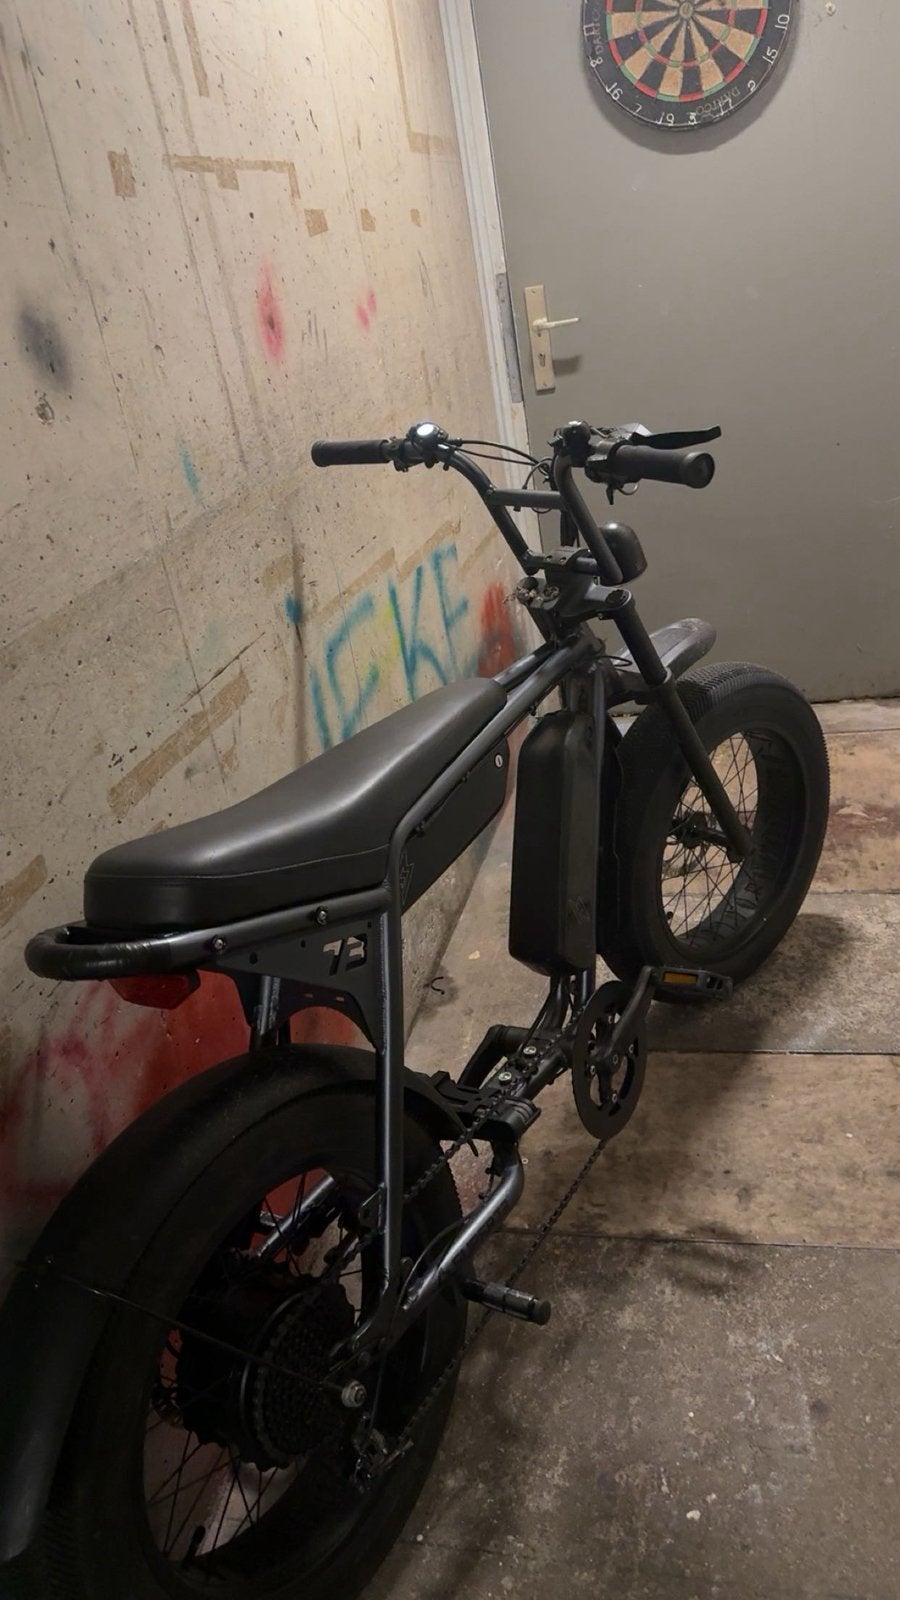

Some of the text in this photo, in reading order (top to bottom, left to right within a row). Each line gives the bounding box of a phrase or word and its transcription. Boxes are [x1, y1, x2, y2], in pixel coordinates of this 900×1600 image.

[774, 14, 790, 31] 10
[590, 57, 603, 68] 8
[762, 46, 779, 65] 15
[605, 82, 623, 100] 16
[747, 80, 757, 92] 2
[634, 103, 643, 115] 7
[656, 112, 675, 127] 19
[322, 933, 367, 976] 73
